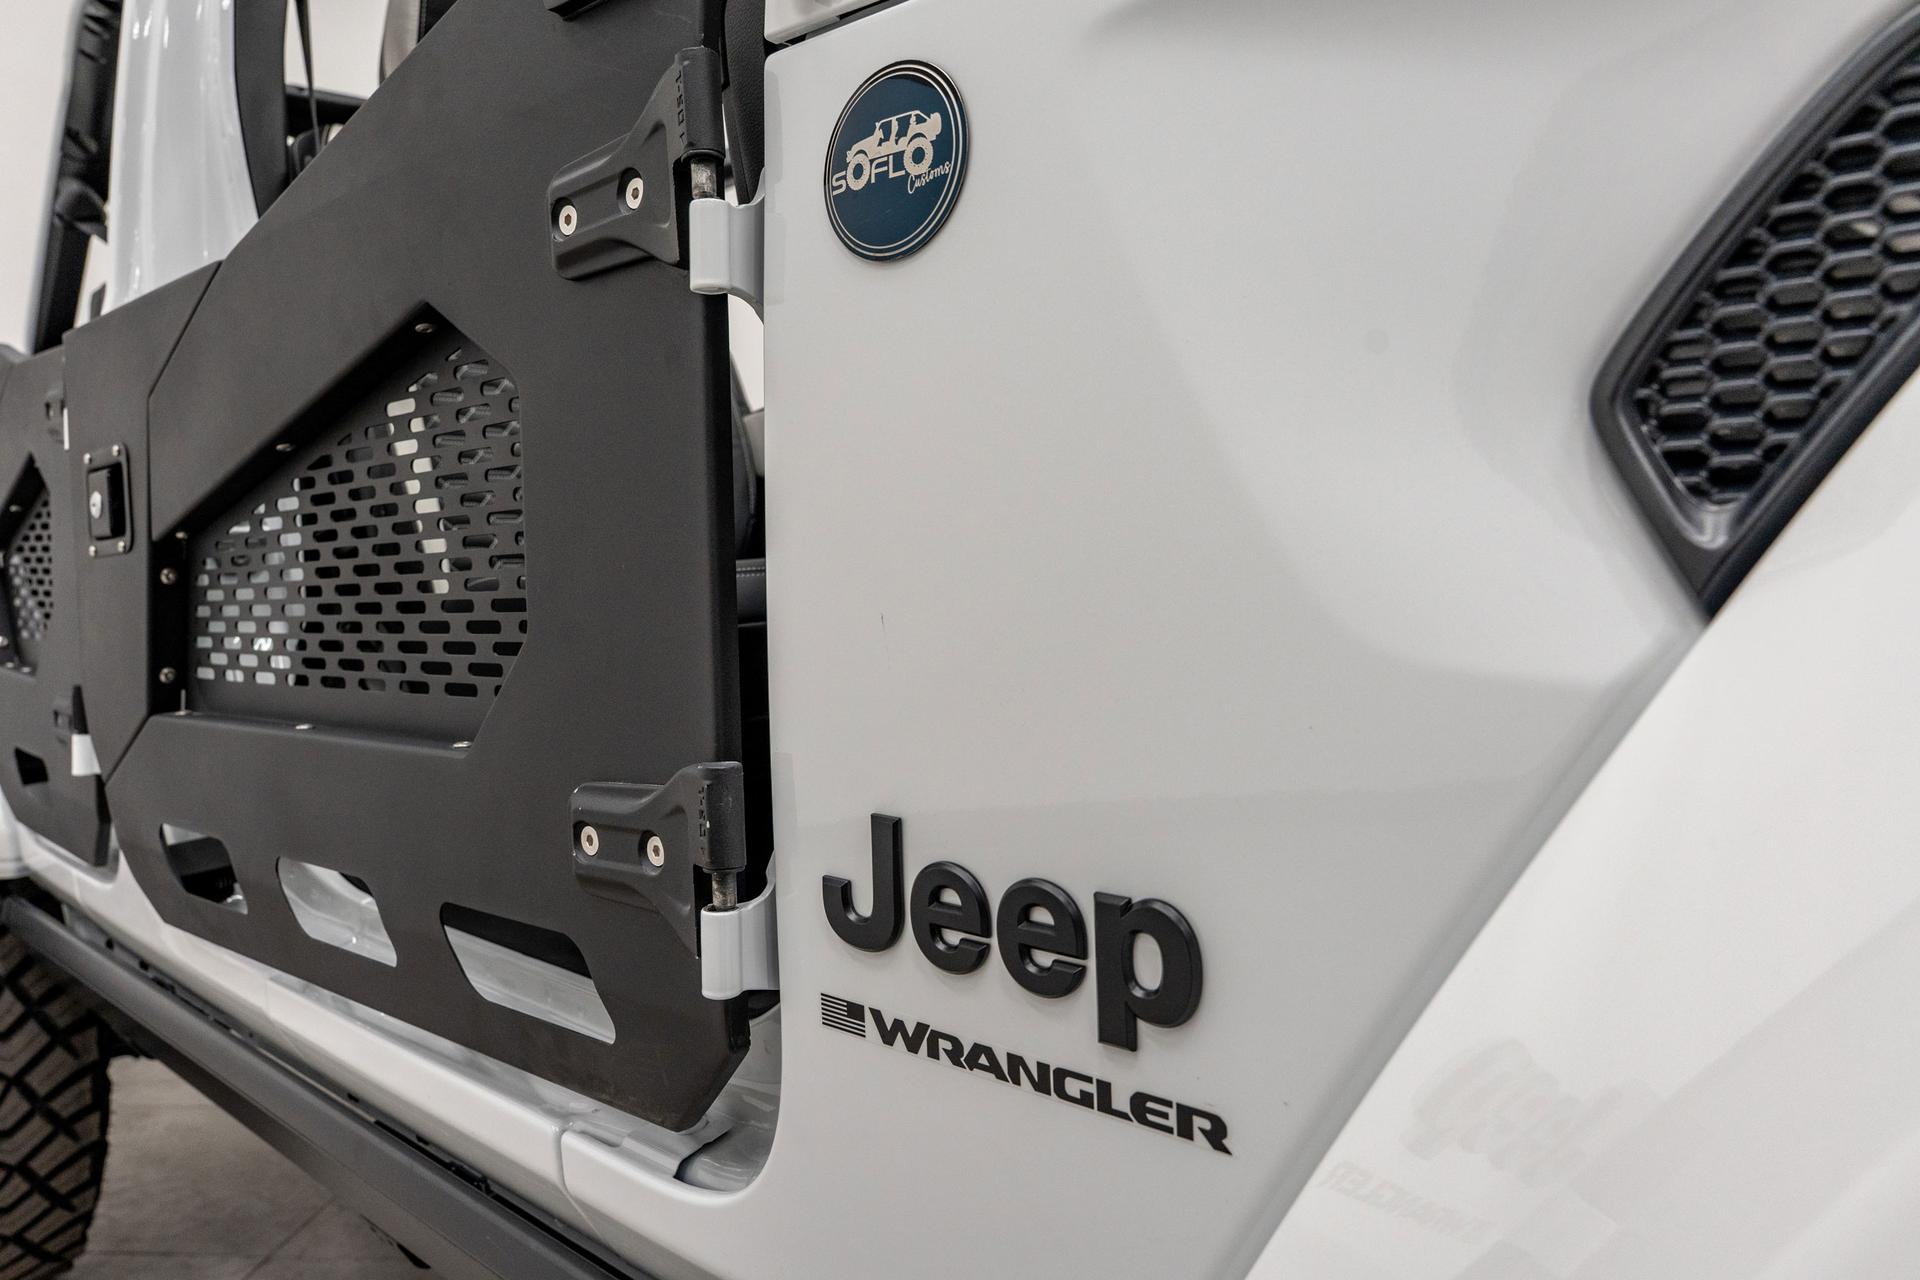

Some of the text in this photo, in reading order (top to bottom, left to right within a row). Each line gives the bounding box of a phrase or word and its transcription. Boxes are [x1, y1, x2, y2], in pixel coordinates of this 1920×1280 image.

[907, 161, 951, 194] Customs
[822, 813, 1204, 1052] Jeep
[868, 1007, 1233, 1156] WRANGLER
